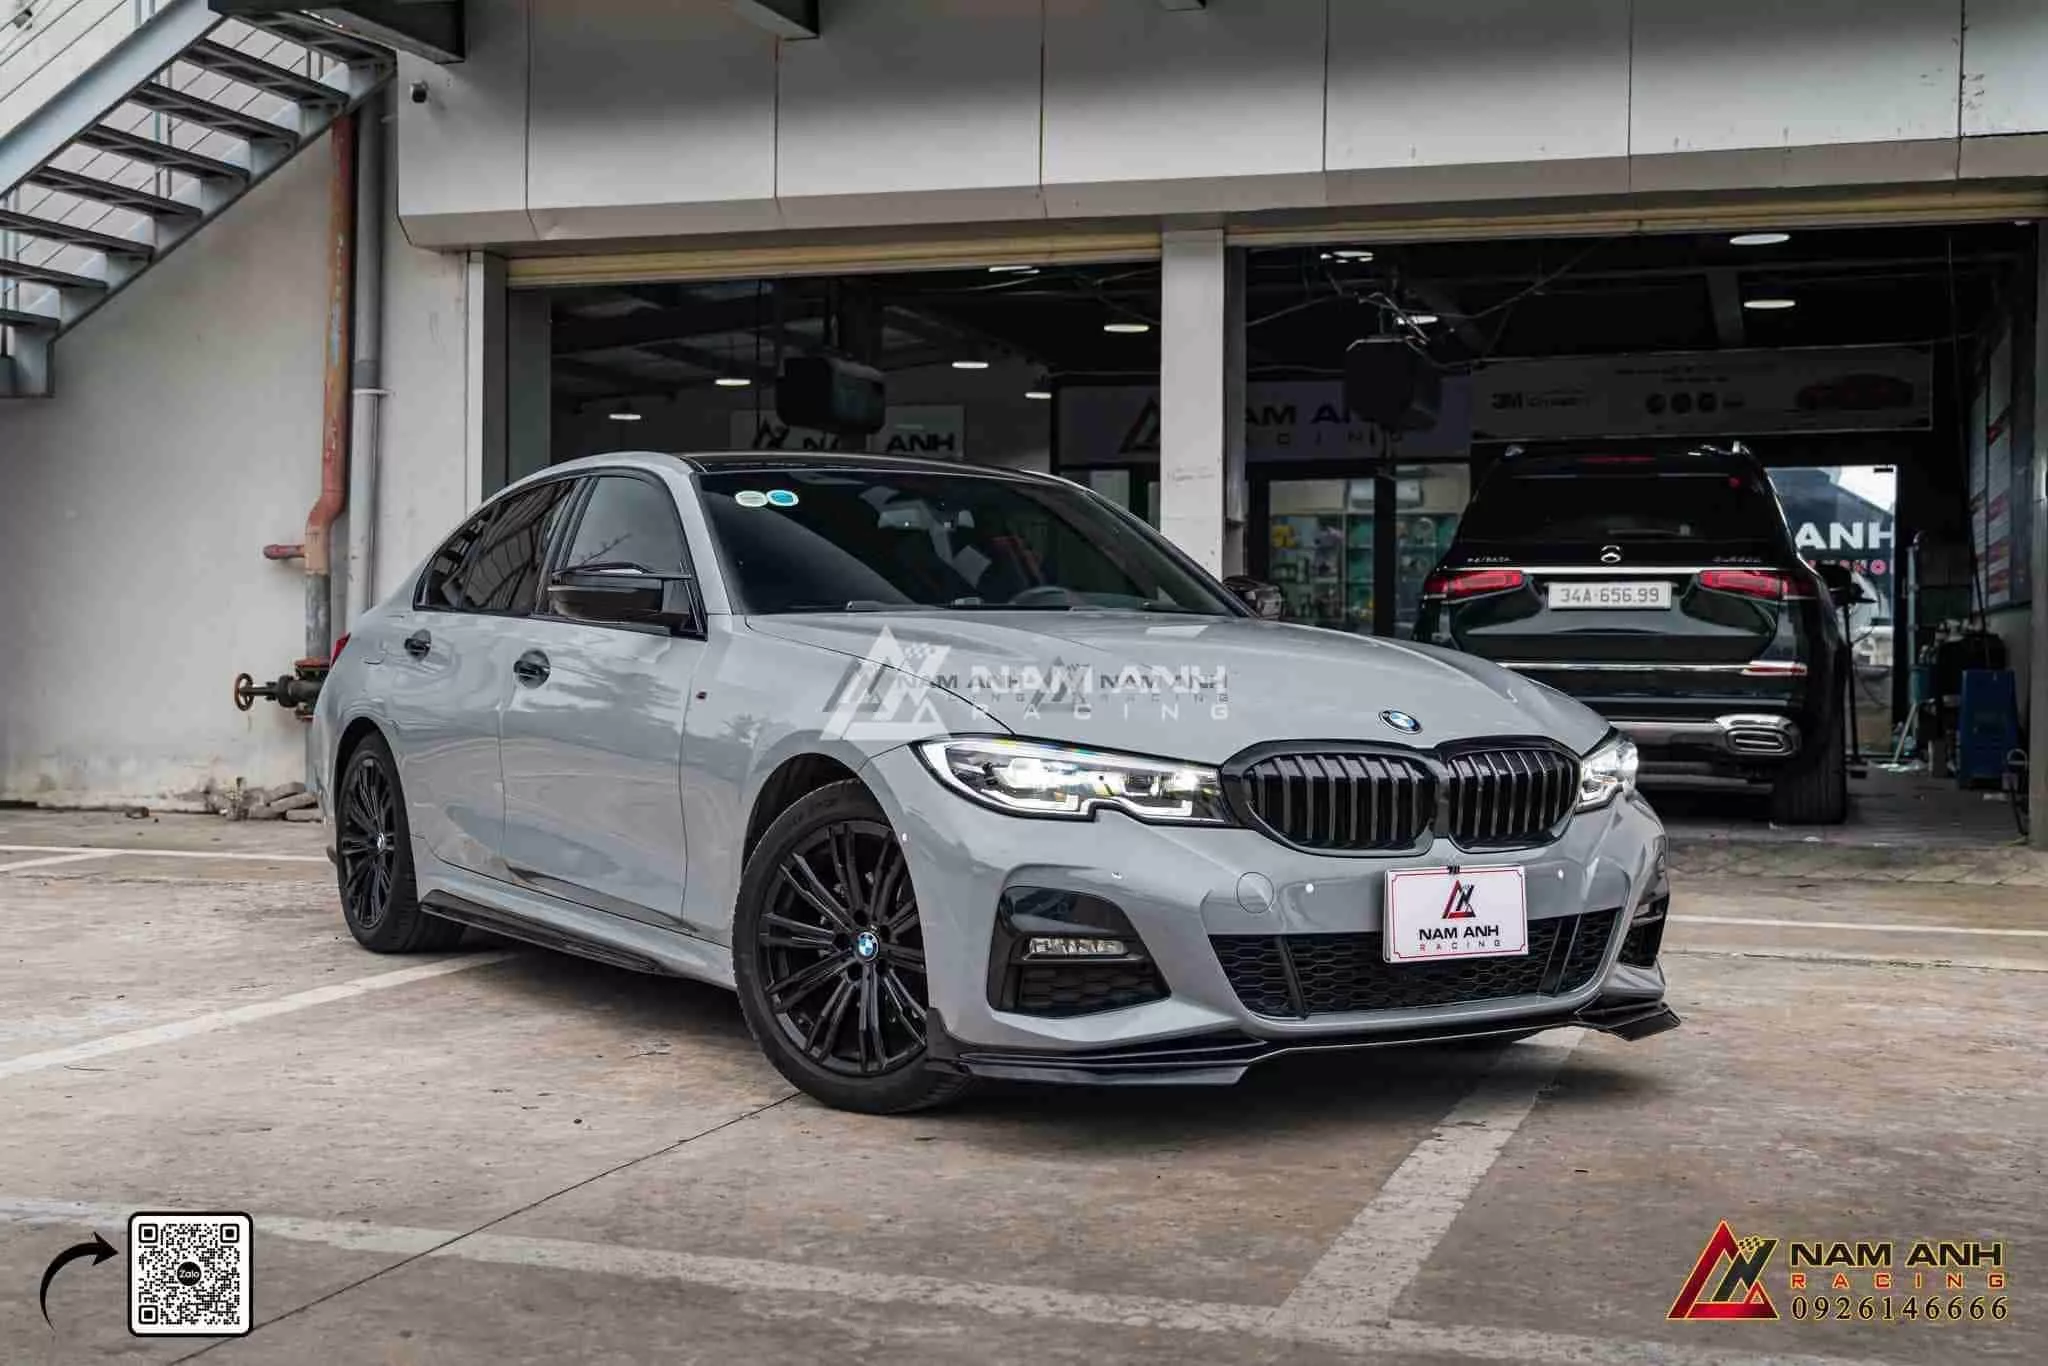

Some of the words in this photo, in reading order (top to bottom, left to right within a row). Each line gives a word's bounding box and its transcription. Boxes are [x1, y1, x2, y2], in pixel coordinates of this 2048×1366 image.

[1246, 405, 1296, 425] AM
[886, 433, 954, 452] ANH
[1795, 522, 1894, 549] ANH
[1418, 927, 1458, 941] NAM
[1463, 924, 1499, 938] ANH
[1418, 939, 1501, 952] RACING
